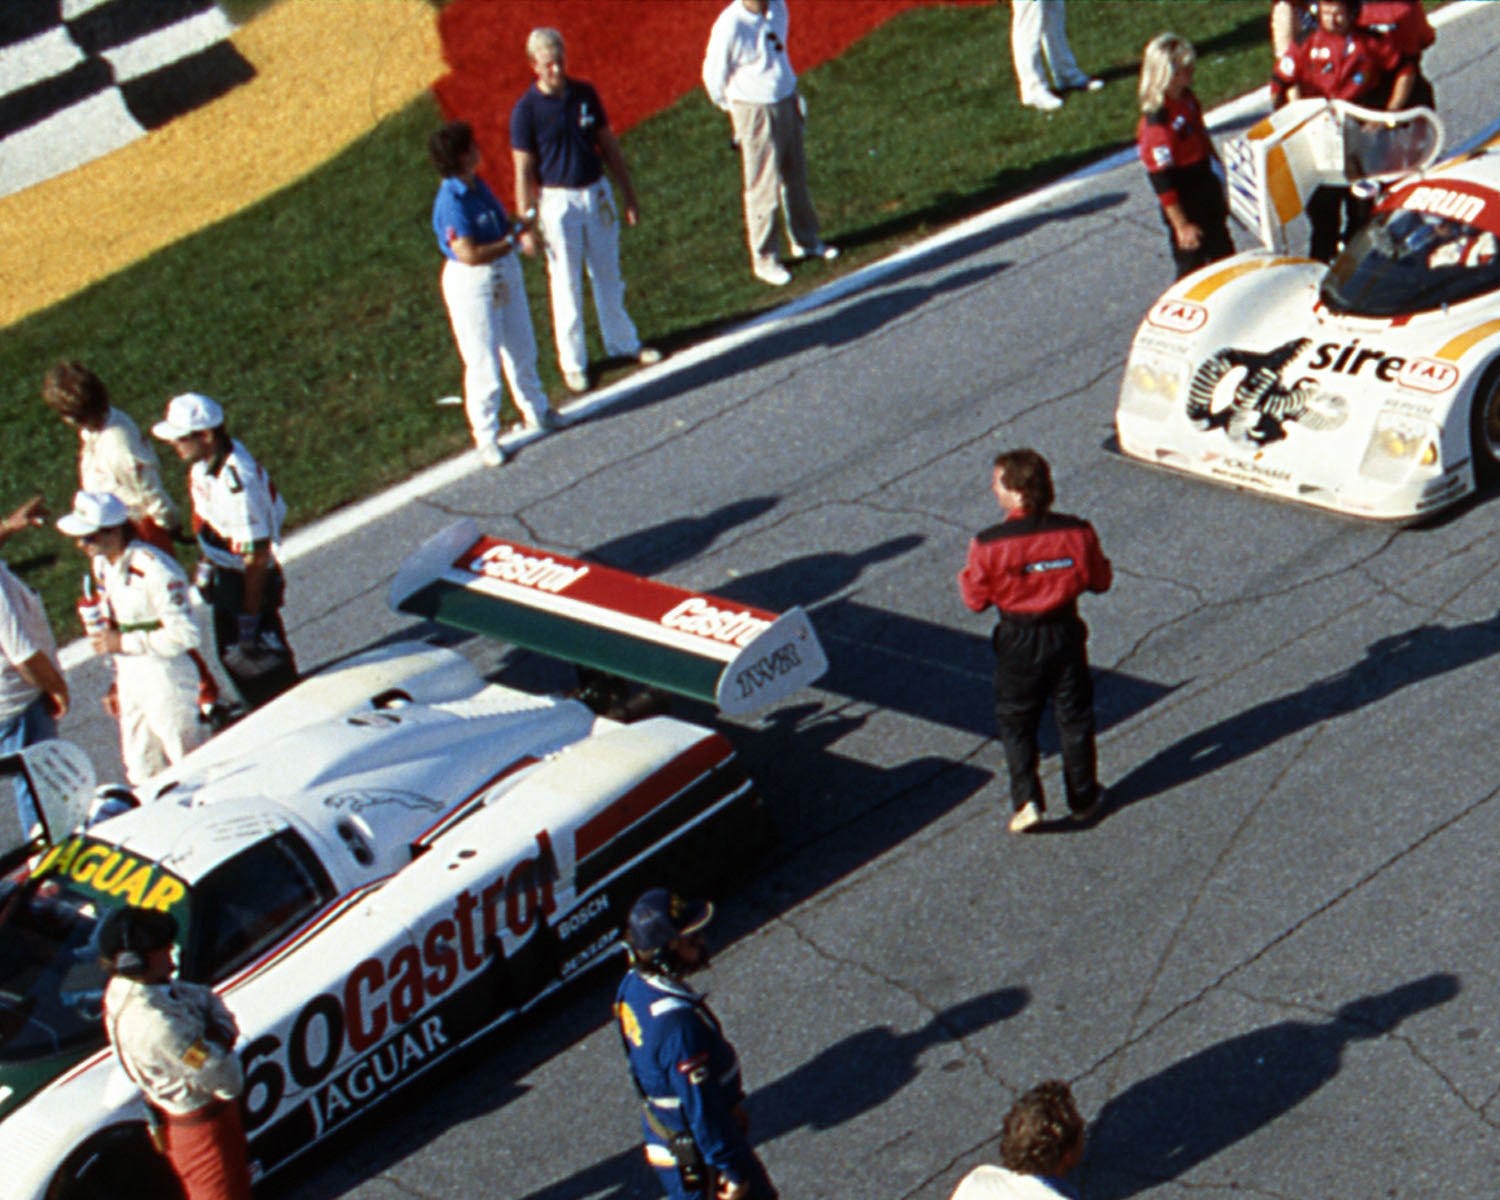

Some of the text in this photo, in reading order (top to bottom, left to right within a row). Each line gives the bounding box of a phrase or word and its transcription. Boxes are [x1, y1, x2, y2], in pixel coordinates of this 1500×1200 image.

[1402, 186, 1486, 223] BRUN
[1308, 339, 1406, 382] sire
[470, 545, 590, 593] Castrol
[661, 597, 773, 648] Castro
[735, 643, 800, 698] TWR
[30, 838, 186, 912] JAGUAR
[344, 828, 560, 1054] Castrol
[558, 894, 610, 939] BOSCH
[304, 1014, 450, 1141] JAGUAR
